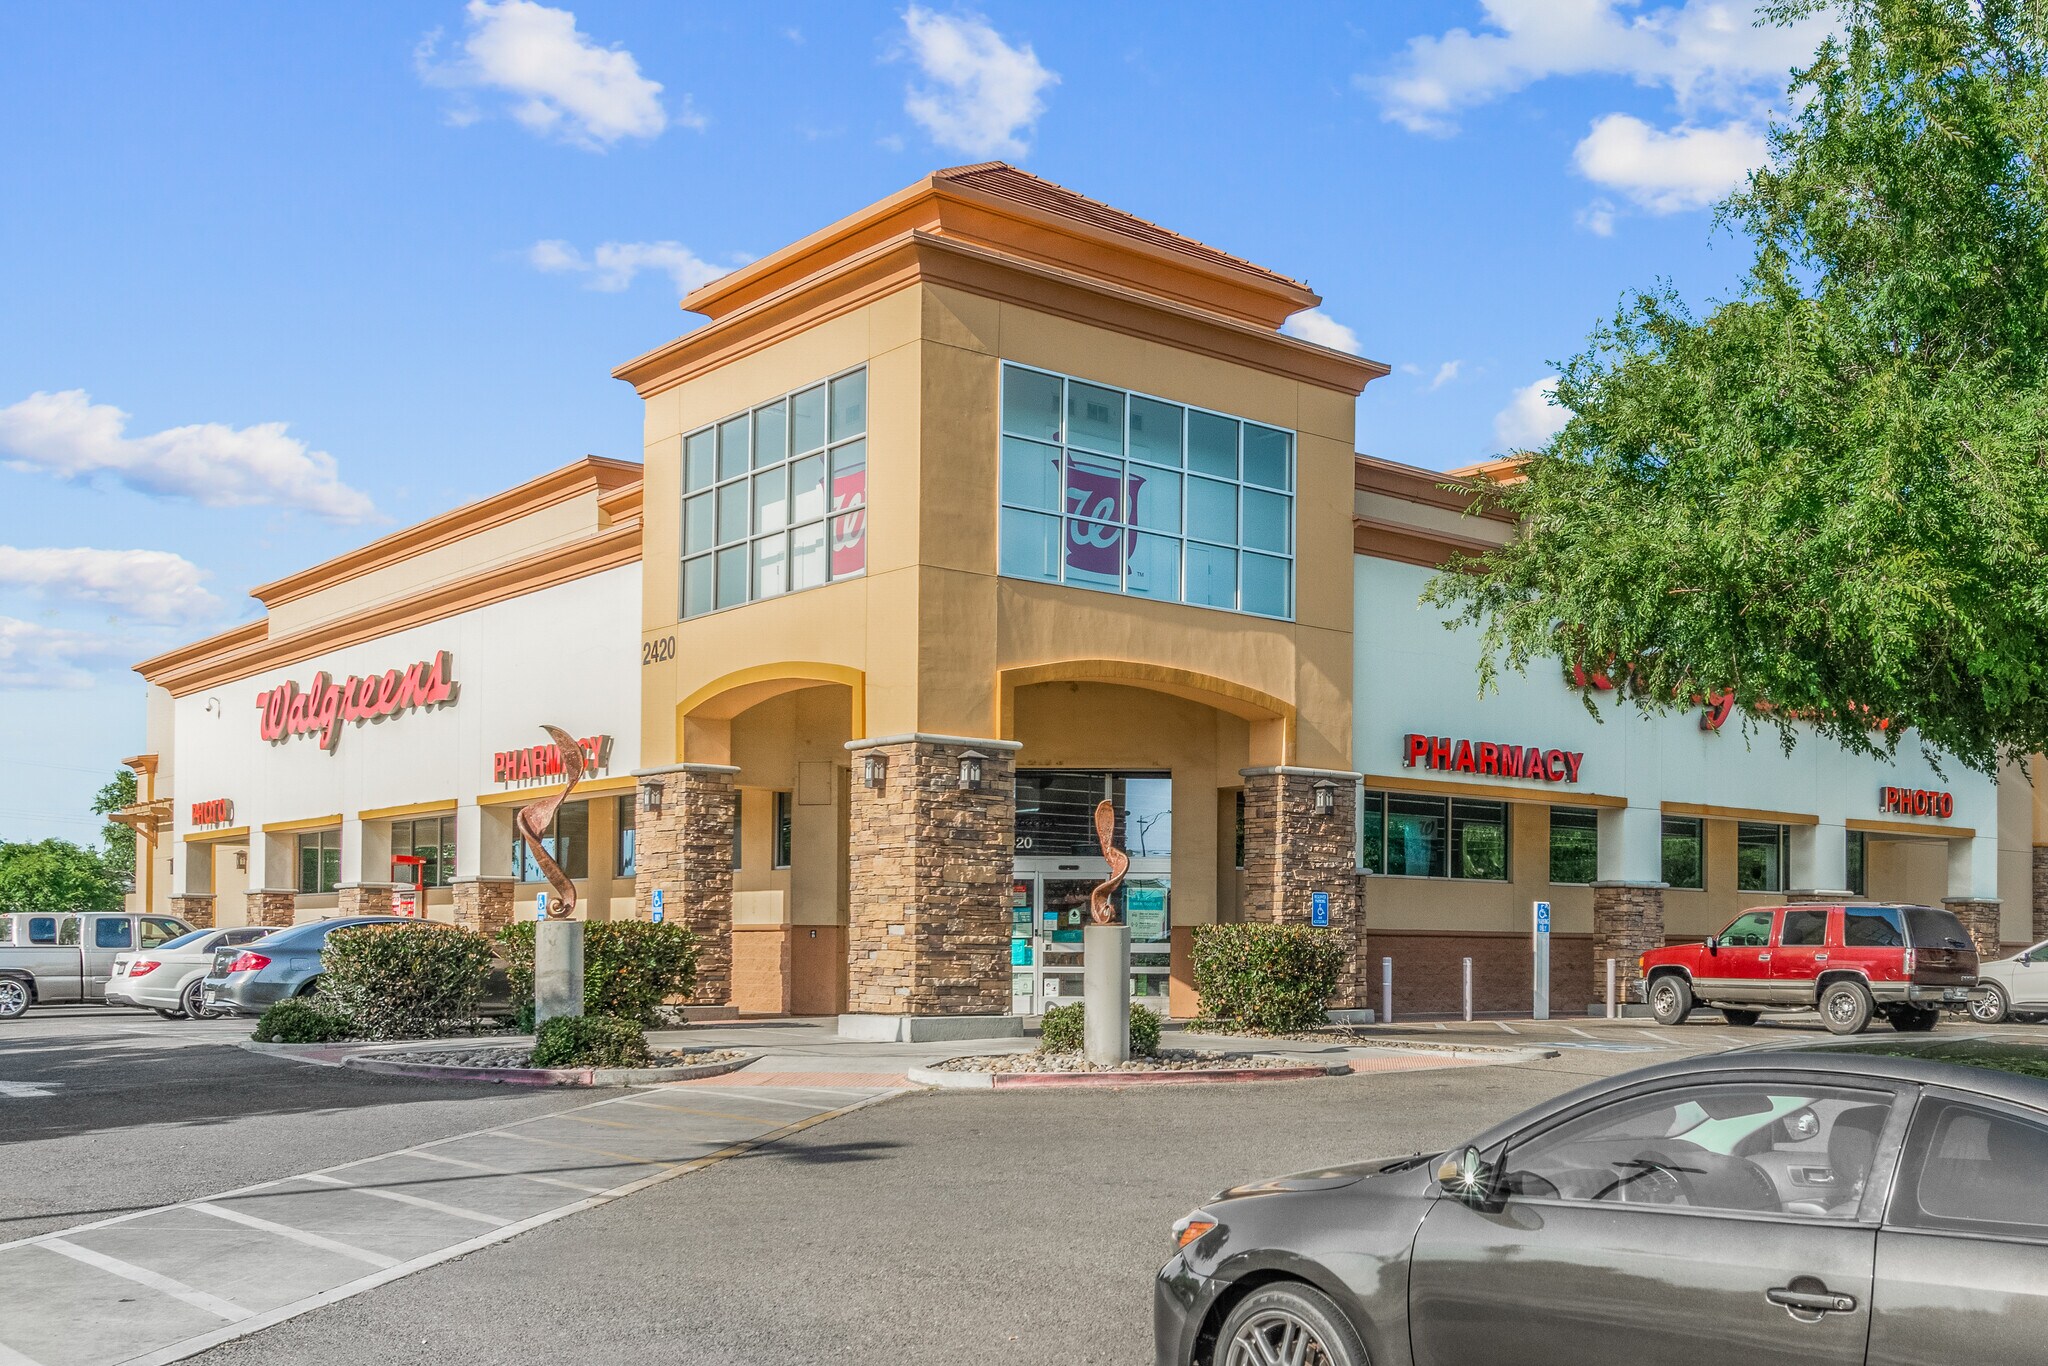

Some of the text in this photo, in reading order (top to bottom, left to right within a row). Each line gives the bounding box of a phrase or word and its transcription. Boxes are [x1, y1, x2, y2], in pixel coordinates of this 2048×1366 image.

[643, 636, 676, 665] 2420
[256, 650, 453, 750] Walgreens
[494, 735, 603, 783] PHARMCY
[1406, 734, 1583, 783] PHARMACY
[192, 798, 227, 826] PHOTO
[1882, 786, 1954, 818] PHOTO
[1014, 836, 1033, 849] 20
